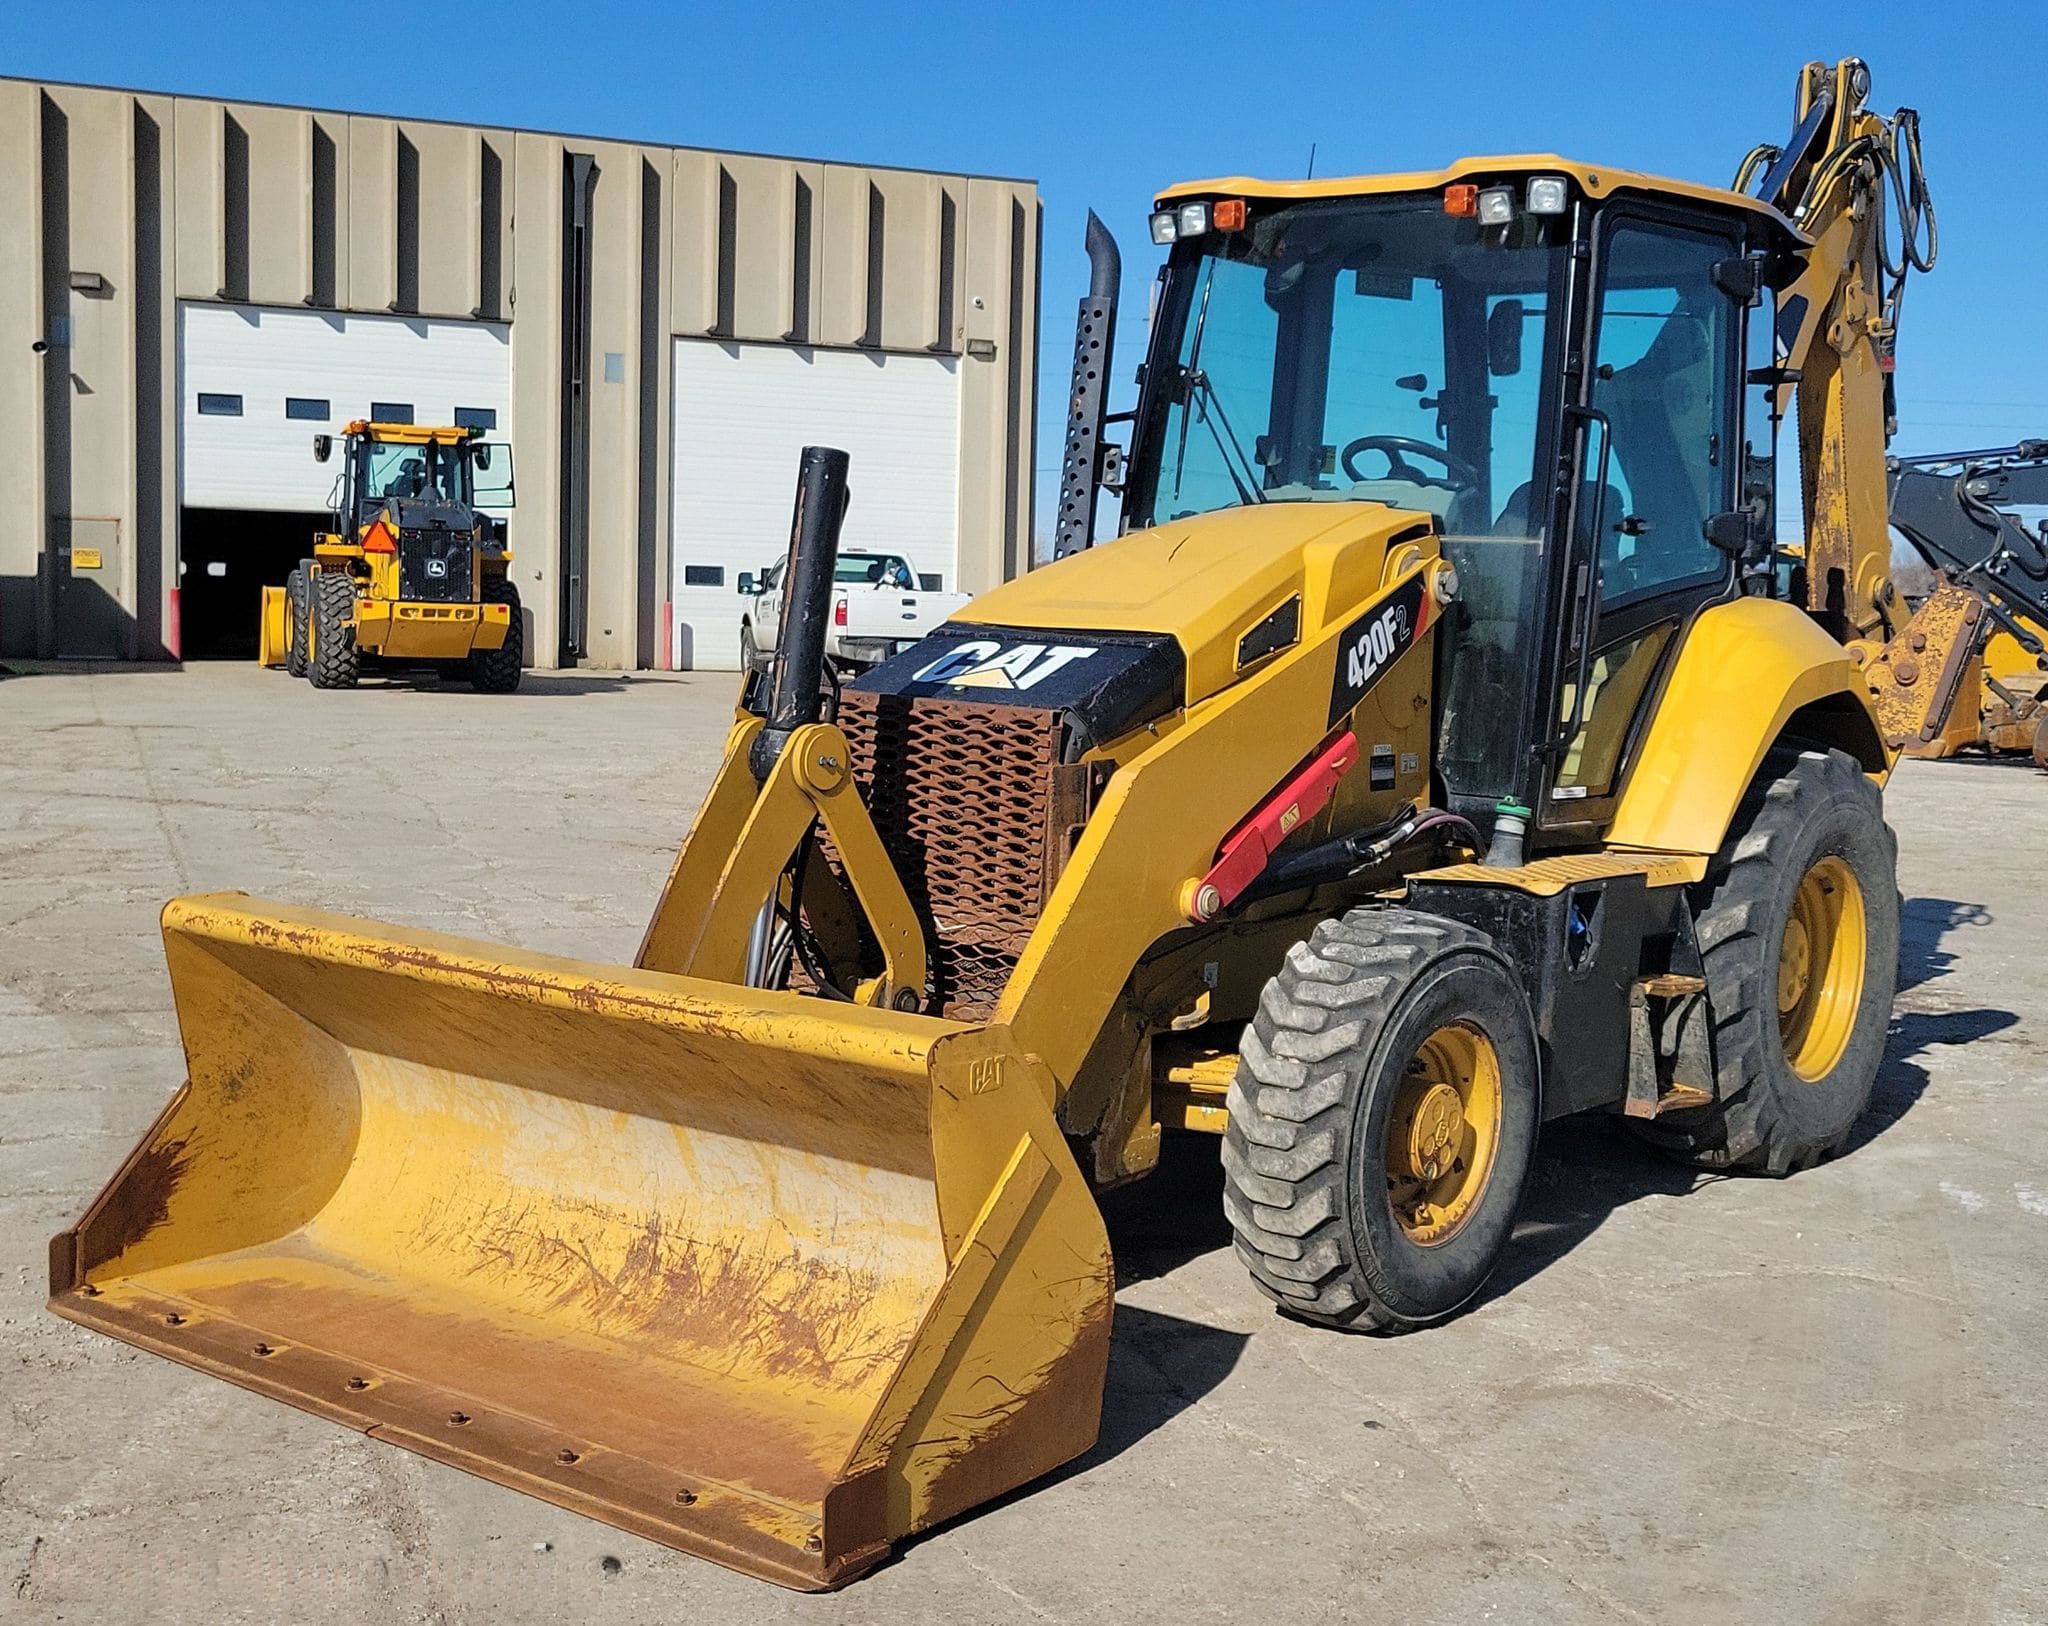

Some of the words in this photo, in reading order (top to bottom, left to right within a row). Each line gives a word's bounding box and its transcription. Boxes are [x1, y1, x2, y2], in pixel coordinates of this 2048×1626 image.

[912, 641, 1099, 690] CAT
[1348, 604, 1411, 688] 420F2
[969, 1054, 1006, 1095] CAT
